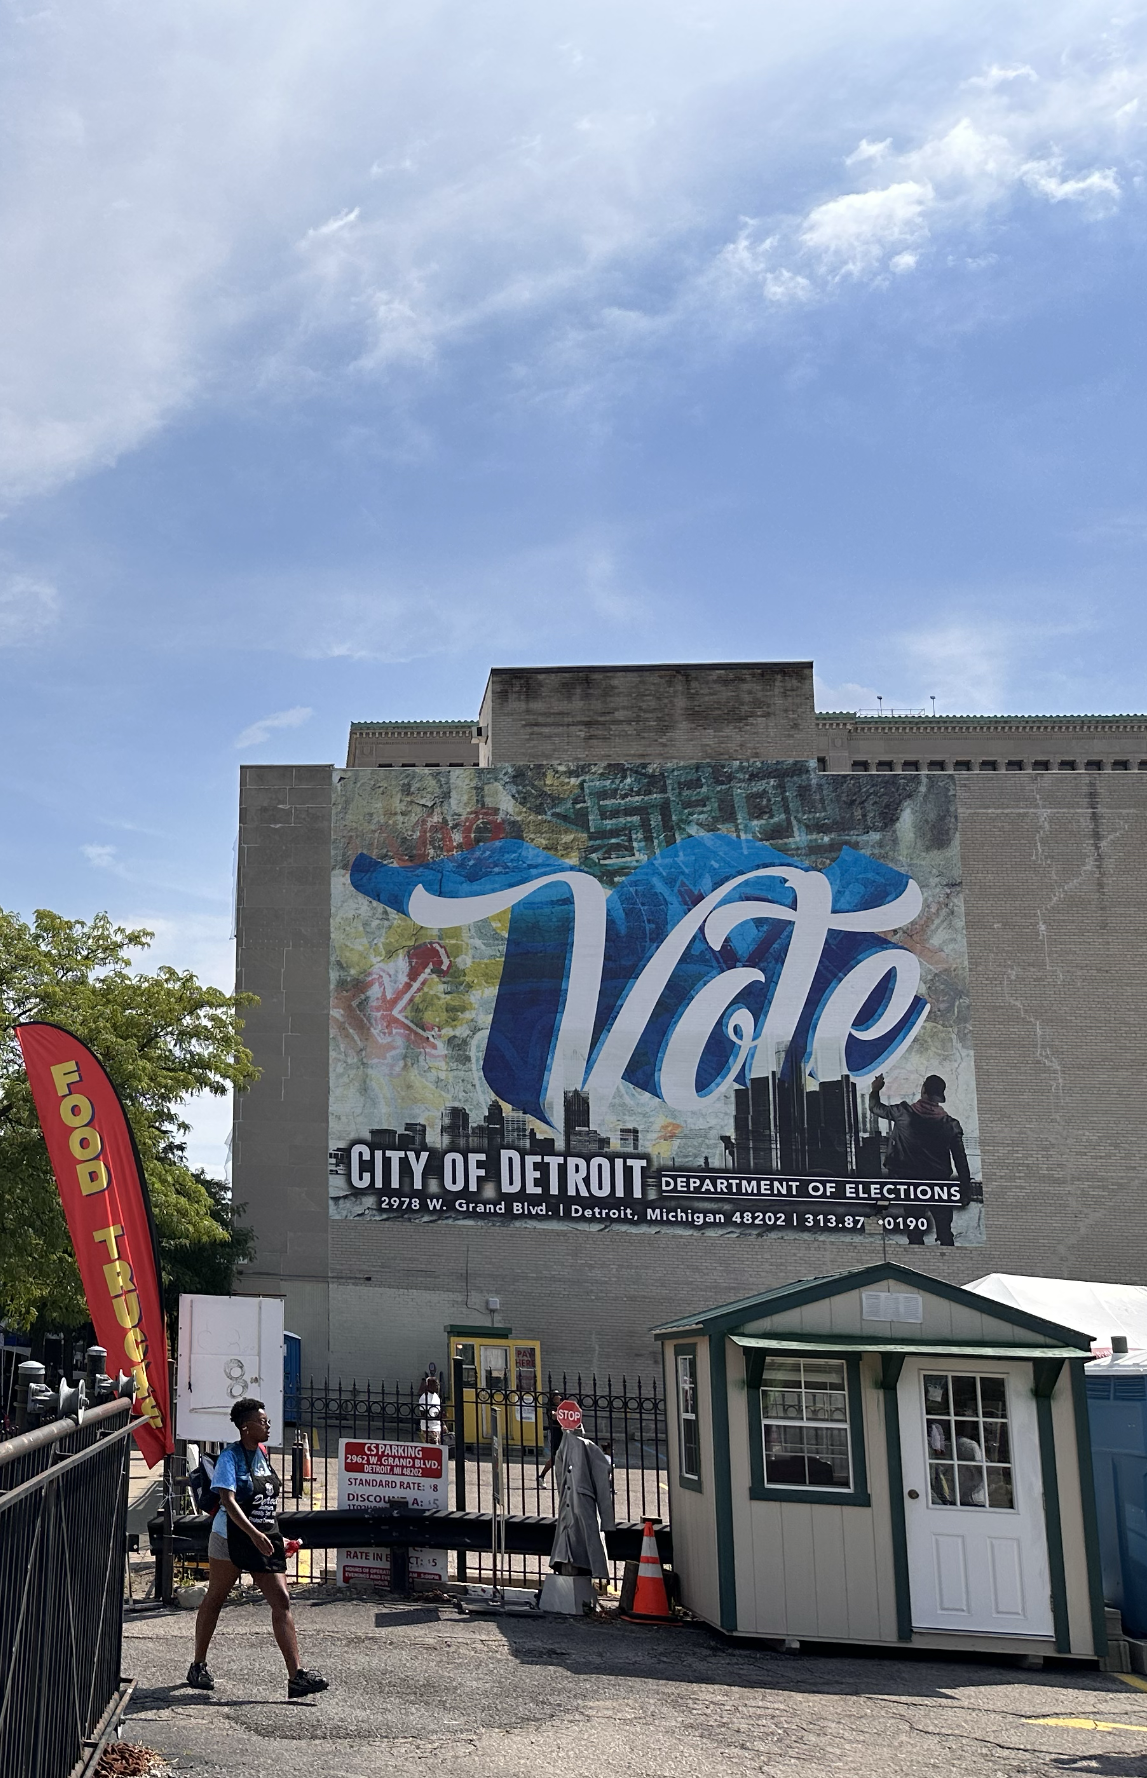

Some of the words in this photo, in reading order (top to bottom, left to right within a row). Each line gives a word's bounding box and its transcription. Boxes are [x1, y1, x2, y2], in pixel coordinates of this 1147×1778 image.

[408, 864, 931, 1112] Vote
[50, 1060, 112, 1197] FOOD
[350, 1143, 430, 1189] CITY
[442, 1151, 488, 1193] OF
[500, 1148, 648, 1199] DETROIT
[661, 1177, 801, 1196] DEPARTMENT
[807, 1182, 837, 1197] OF
[844, 1183, 962, 1201] ELECTIONS
[380, 1196, 420, 1211] 2978
[426, 1198, 448, 1211] W.
[455, 1199, 506, 1214] Grand
[512, 1202, 553, 1216] Blvd.
[570, 1204, 639, 1221] Detroit,
[646, 1208, 726, 1226] Michigan
[731, 1211, 787, 1226] 48202
[516, 1349, 533, 1358] PAY
[515, 1358, 535, 1367] HERE
[558, 1410, 581, 1421] STOP
[364, 1443, 377, 1454] CS
[378, 1444, 423, 1458] PARKING
[346, 1454, 367, 1464] 2962
[368, 1455, 380, 1464] W.
[381, 1456, 413, 1468] GRAND
[414, 1459, 441, 1469] BLVD.
[364, 1464, 393, 1475] DETROIT,
[393, 1466, 402, 1475] MI
[402, 1466, 423, 1476] 48202
[347, 1477, 397, 1489] STANDARD
[399, 1481, 425, 1492] RATE:
[347, 1492, 407, 1504] DISCOU
[411, 1497, 423, 1507] A:
[345, 1550, 370, 1560] RATE
[372, 1552, 383, 1562] IN
[345, 1571, 369, 1579] EVENINGS
